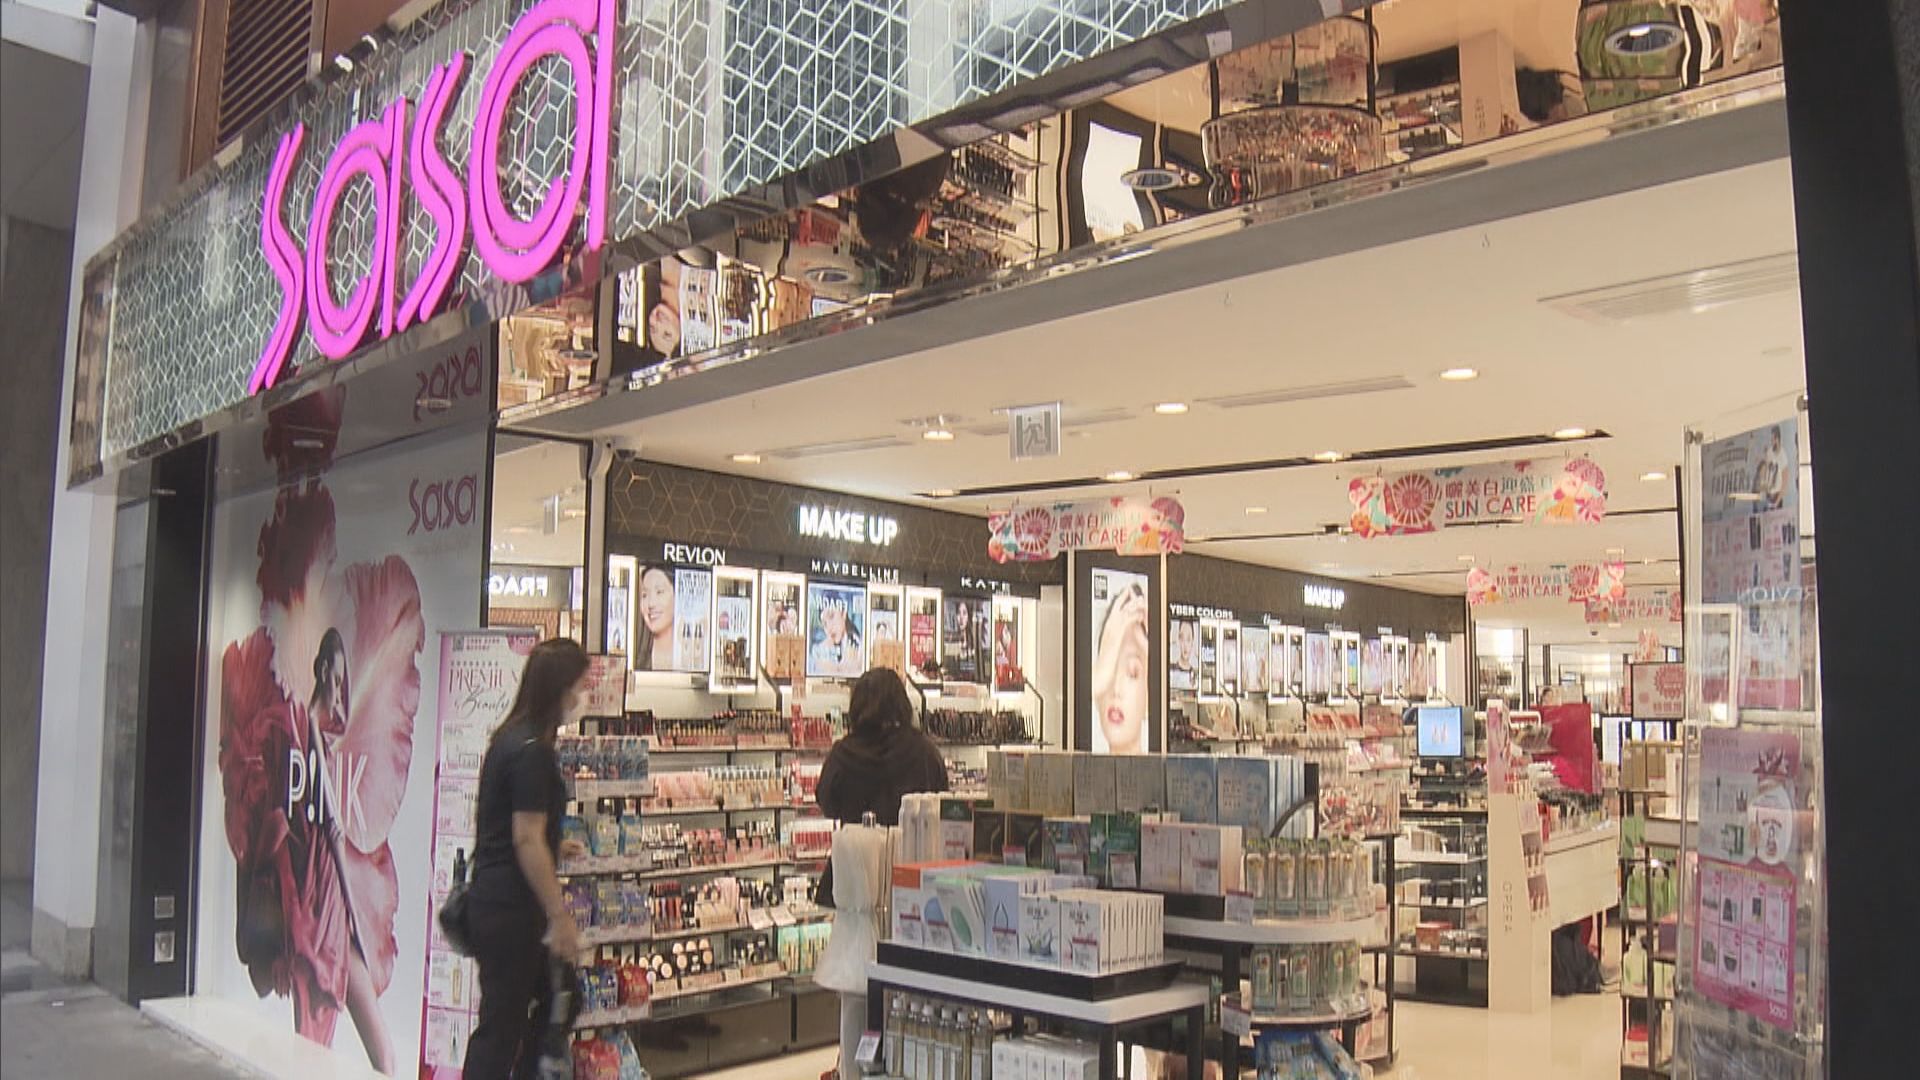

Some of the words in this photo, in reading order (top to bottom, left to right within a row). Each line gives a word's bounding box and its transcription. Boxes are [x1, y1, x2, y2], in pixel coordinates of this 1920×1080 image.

[1445, 498, 1479, 519] SUN
[1485, 494, 1537, 515] CARE
[800, 504, 865, 543] MAKE
[868, 513, 898, 547] UP
[1058, 530, 1084, 548] SUN
[1088, 527, 1127, 545] CARE
[663, 543, 726, 566] REVLON
[811, 559, 899, 582] MAYBELLINE
[961, 577, 1011, 594] KATE
[1304, 584, 1332, 609] MAKE
[1331, 588, 1345, 610] UP
[1508, 586, 1530, 599] SUN
[1532, 585, 1563, 599] CARE
